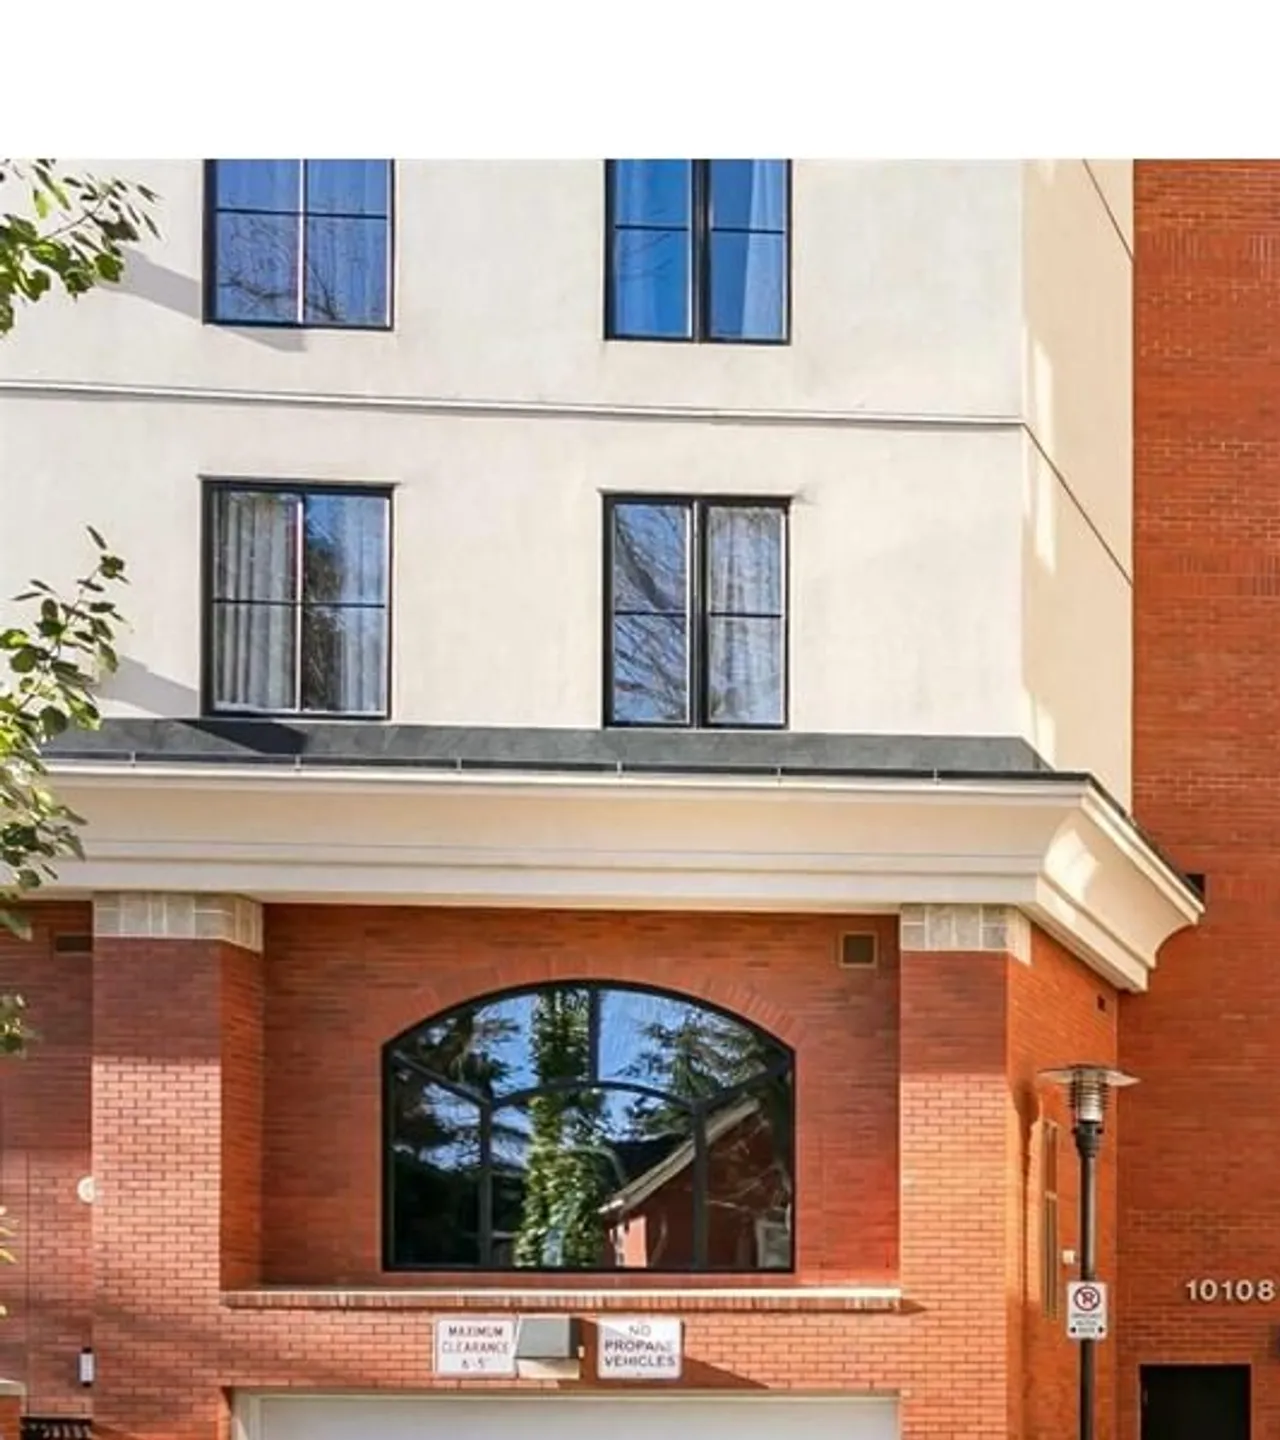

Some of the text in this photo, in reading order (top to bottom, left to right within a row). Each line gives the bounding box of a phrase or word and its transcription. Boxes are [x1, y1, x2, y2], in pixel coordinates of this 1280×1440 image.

[1185, 1279, 1276, 1301] 10108
[448, 1325, 504, 1337] MAXIMUM
[629, 1324, 651, 1337] NO
[442, 1341, 508, 1354] CLEARANCE
[604, 1340, 675, 1352] PROPANE
[604, 1355, 676, 1367] VEHICLES
